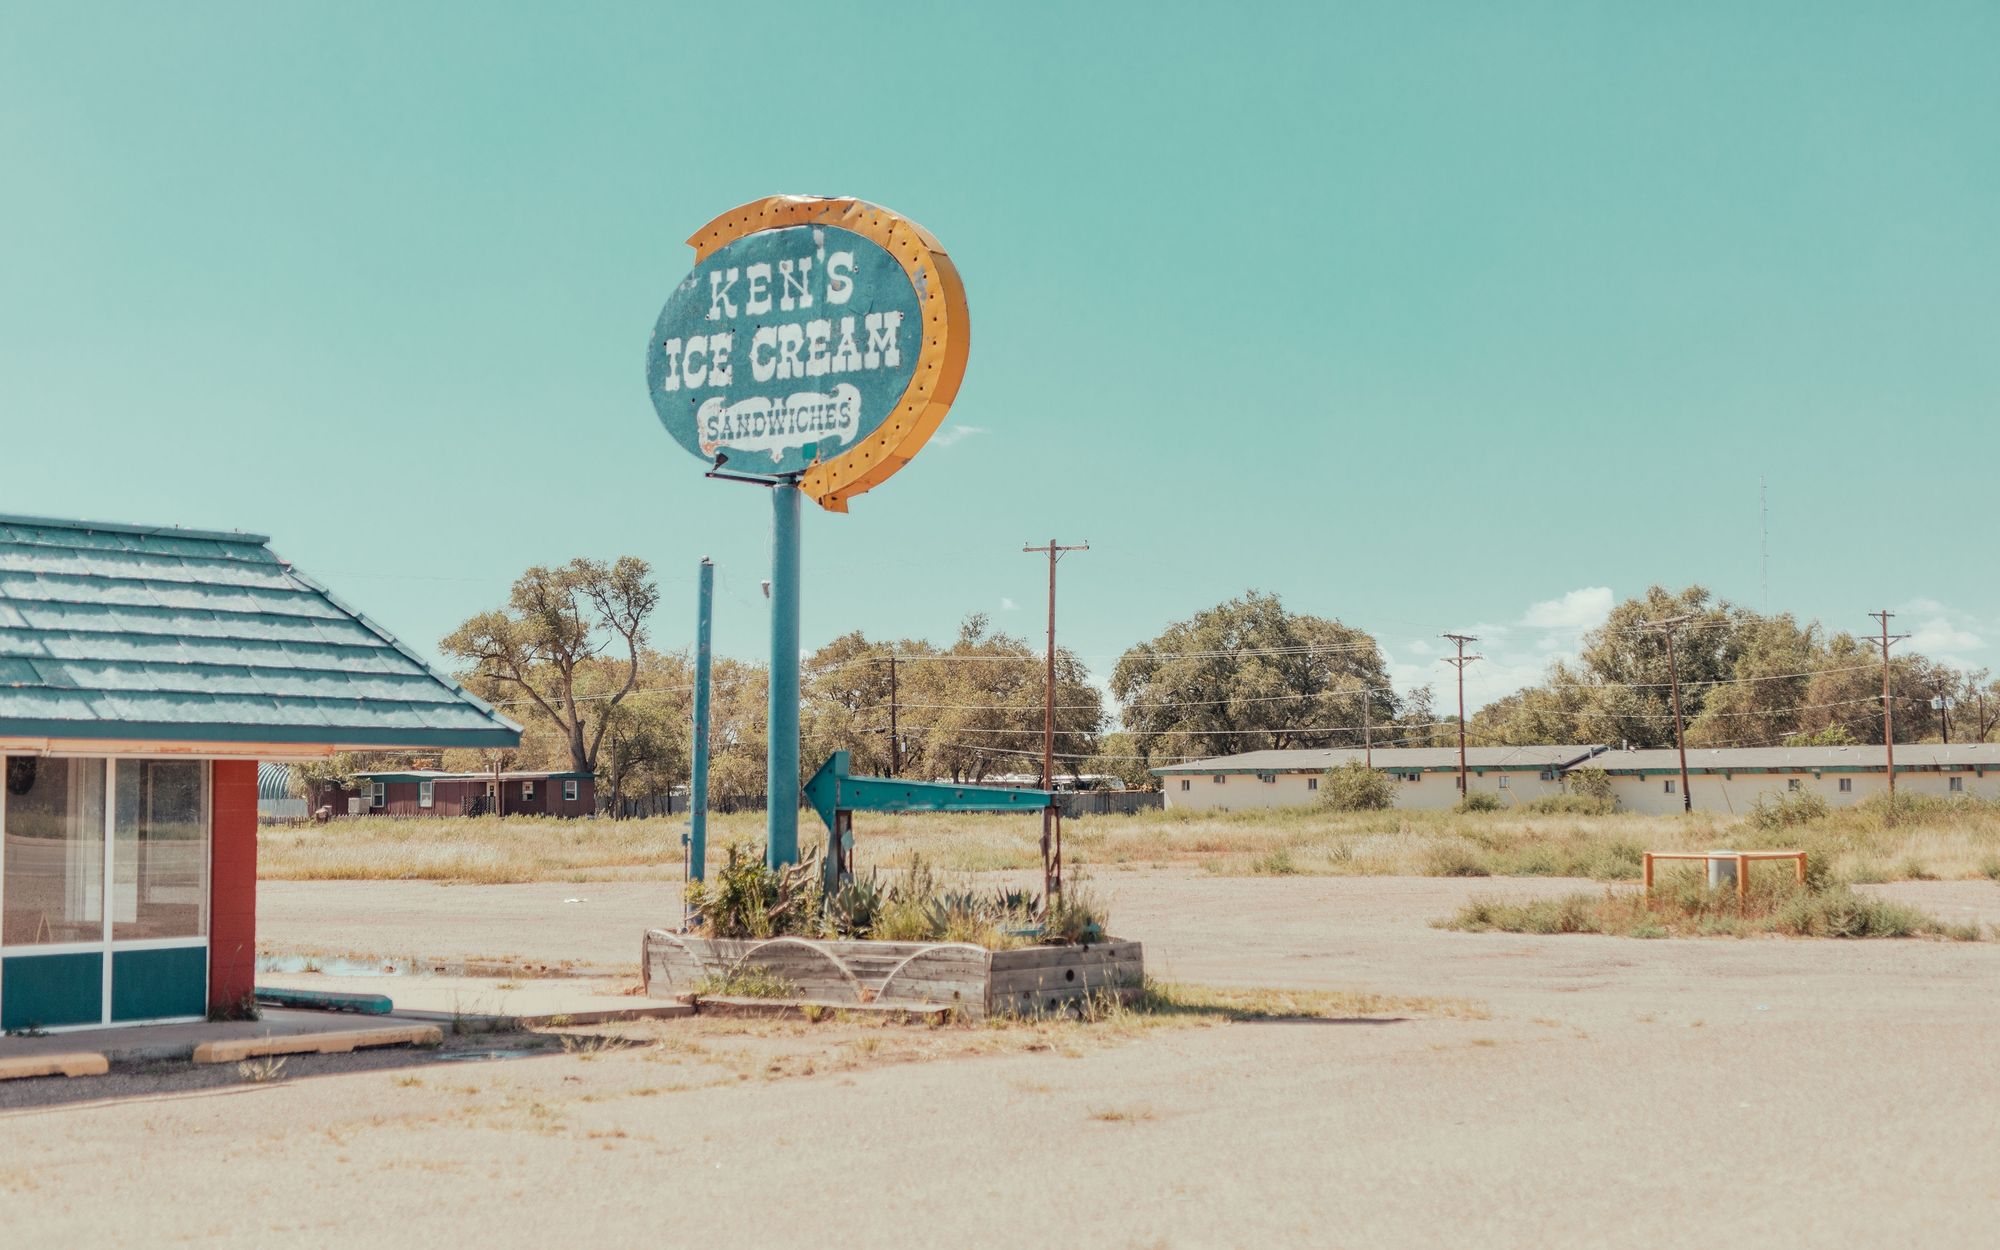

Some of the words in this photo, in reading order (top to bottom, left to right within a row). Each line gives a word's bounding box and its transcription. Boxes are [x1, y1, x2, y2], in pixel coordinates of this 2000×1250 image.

[708, 250, 854, 320] KEN'S
[664, 332, 733, 391] ICE
[750, 310, 901, 382] CREAM
[707, 401, 851, 440] SANDWICHES
